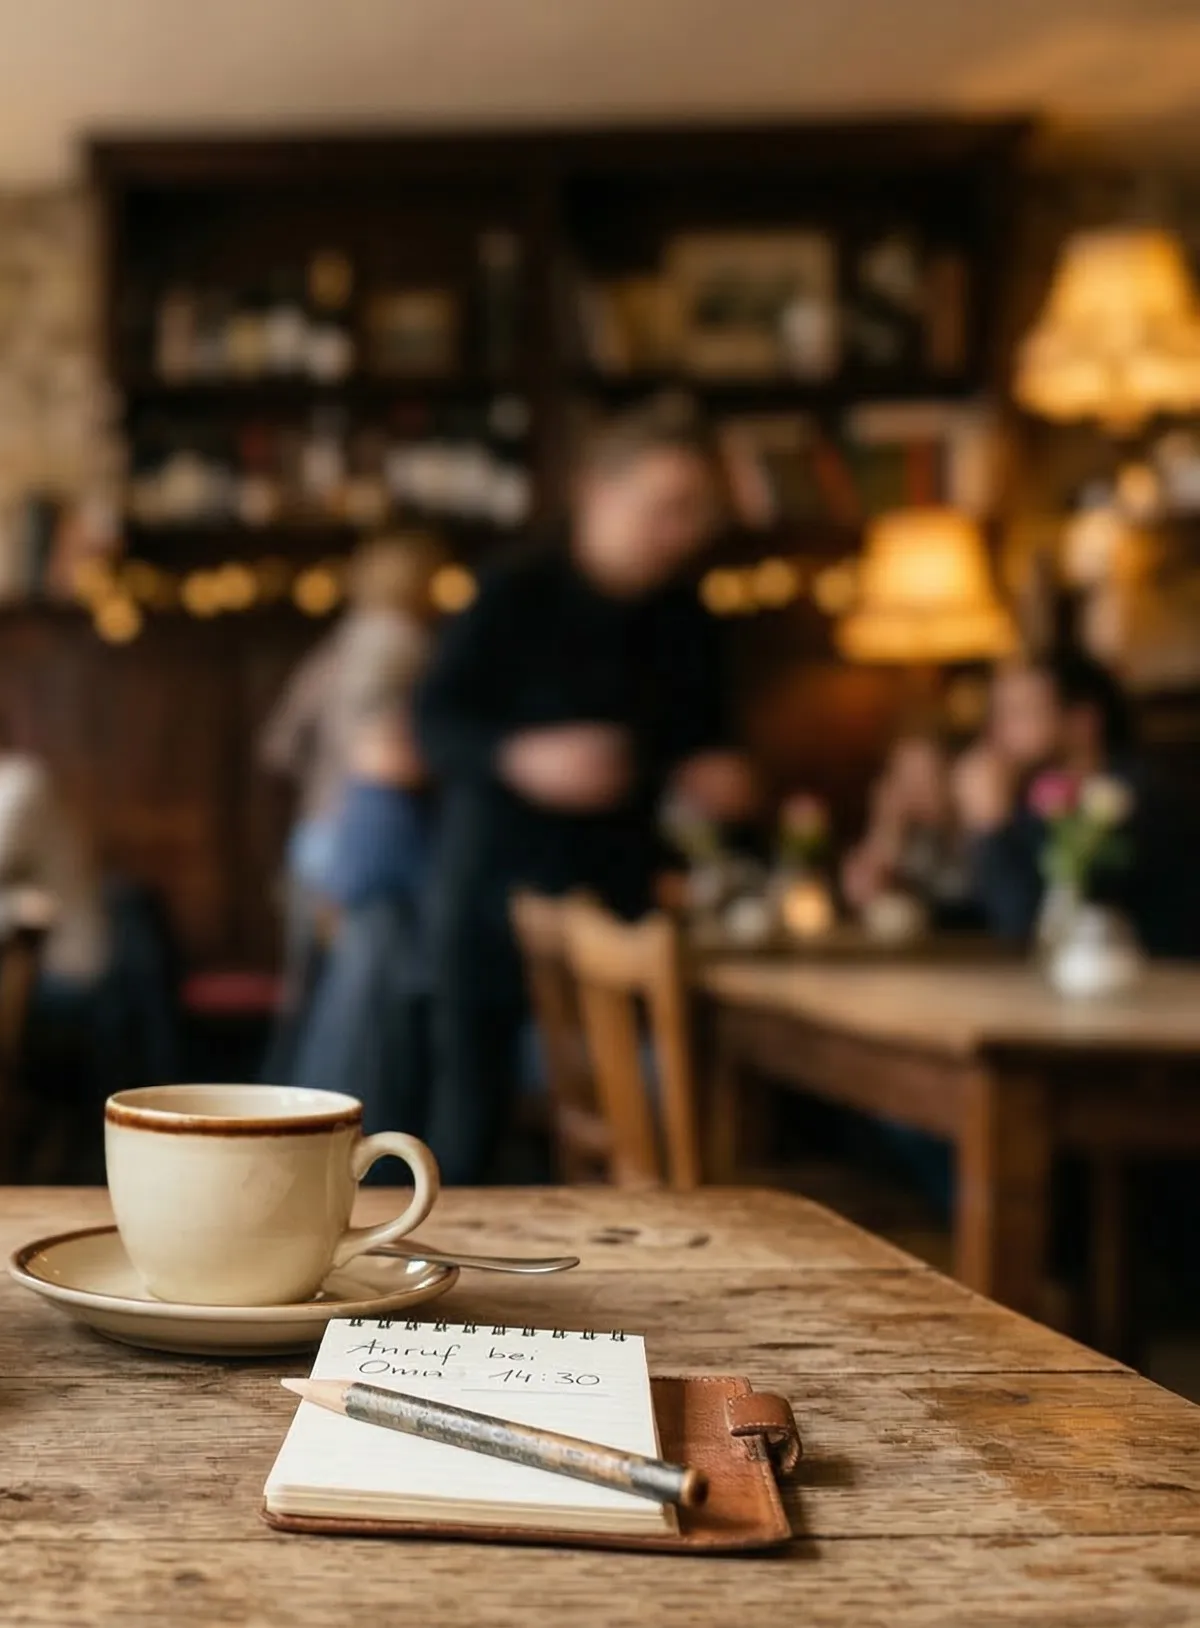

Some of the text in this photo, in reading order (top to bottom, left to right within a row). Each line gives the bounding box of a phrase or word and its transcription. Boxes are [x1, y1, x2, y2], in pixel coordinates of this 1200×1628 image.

[346, 1338, 539, 1366] Anruf bei
[358, 1359, 601, 1386] Oma 14:30
